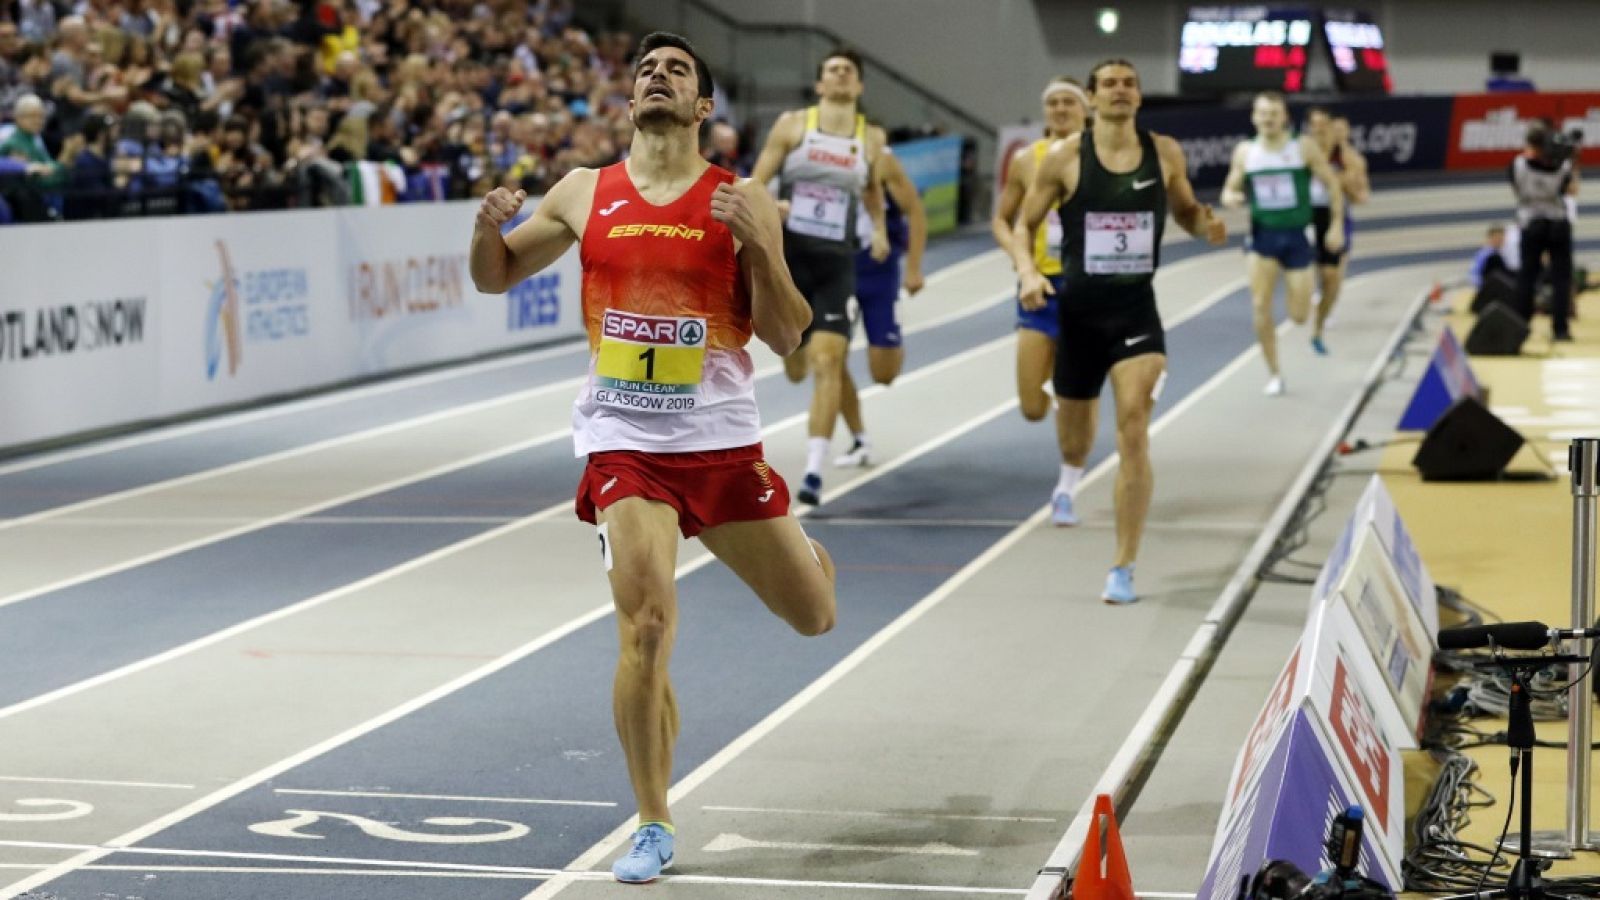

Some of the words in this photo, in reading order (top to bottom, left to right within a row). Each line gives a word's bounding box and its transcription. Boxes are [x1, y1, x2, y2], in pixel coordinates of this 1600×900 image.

[607, 223, 705, 241] ESPAÑA
[1114, 232, 1129, 253] 3
[357, 259, 401, 320] RUN
[405, 254, 465, 314] CLEAN
[97, 297, 146, 345] NOW
[605, 316, 675, 340] SPAR
[639, 348, 656, 380] 1
[620, 381, 640, 392] RUN
[642, 384, 676, 393] CLEAN
[596, 391, 664, 410] GLASGOW
[666, 398, 695, 410] 2019
[247, 809, 531, 843] 2
